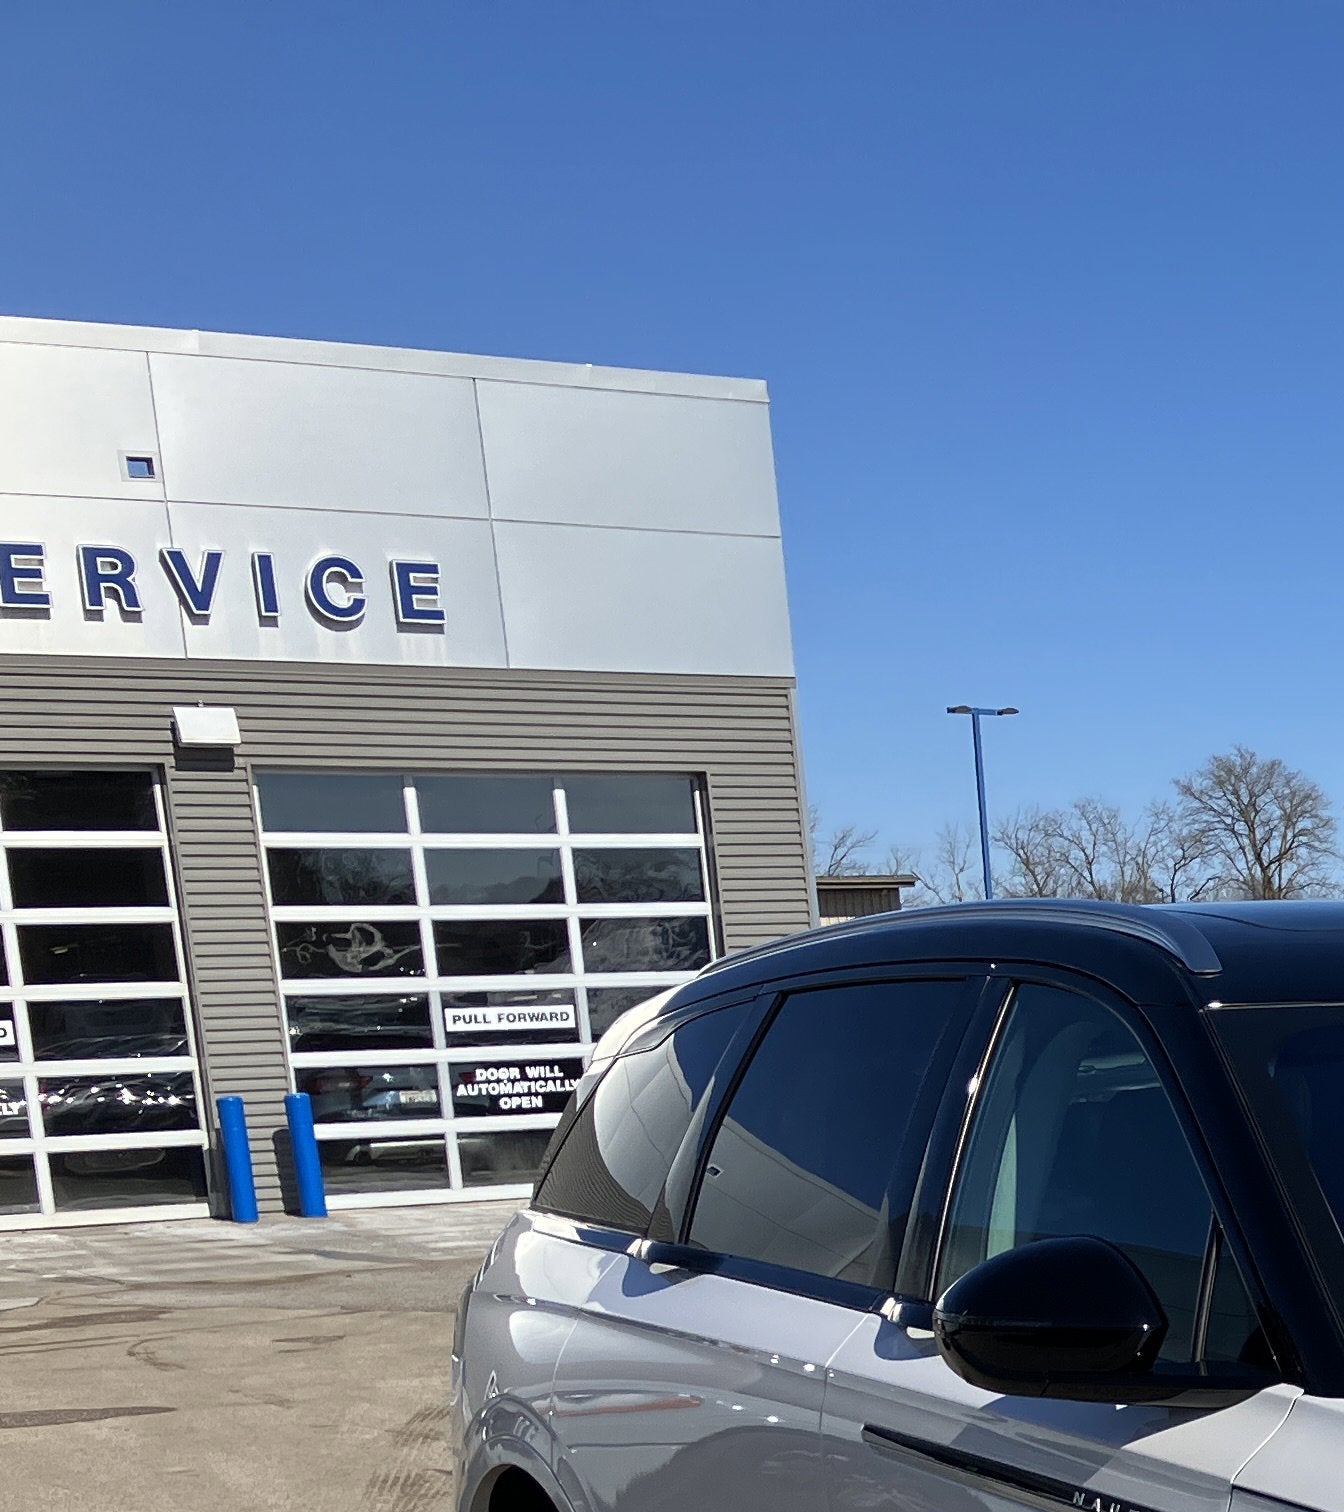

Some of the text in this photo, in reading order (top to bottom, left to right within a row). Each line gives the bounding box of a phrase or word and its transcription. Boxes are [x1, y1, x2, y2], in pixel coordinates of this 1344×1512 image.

[452, 1011, 570, 1025] PULL FORWARD
[475, 1065, 564, 1081] DOOR WILL
[456, 1078, 581, 1097] AUTOMATICALLY
[499, 1095, 543, 1110] OPEN
